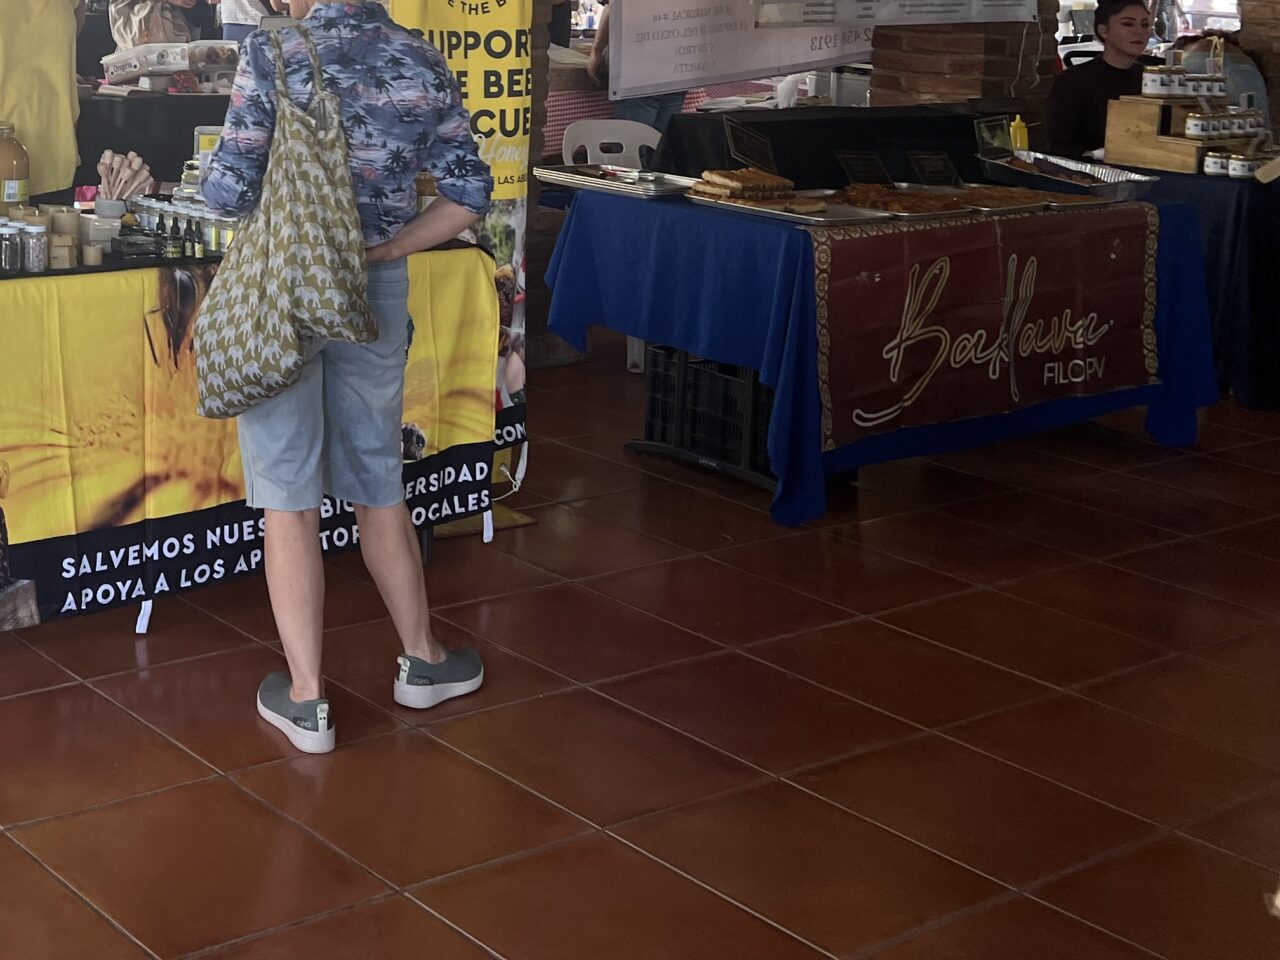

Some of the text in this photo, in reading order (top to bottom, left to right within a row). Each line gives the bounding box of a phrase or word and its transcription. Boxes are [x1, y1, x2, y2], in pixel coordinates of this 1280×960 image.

[460, 0, 491, 16] THE
[410, 28, 531, 59] UPPOR
[498, 175, 515, 185] LAS
[61, 533, 195, 579] SALVEMOS
[60, 578, 146, 613] APOYA
[154, 572, 170, 595] A
[179, 558, 225, 589] LOS
